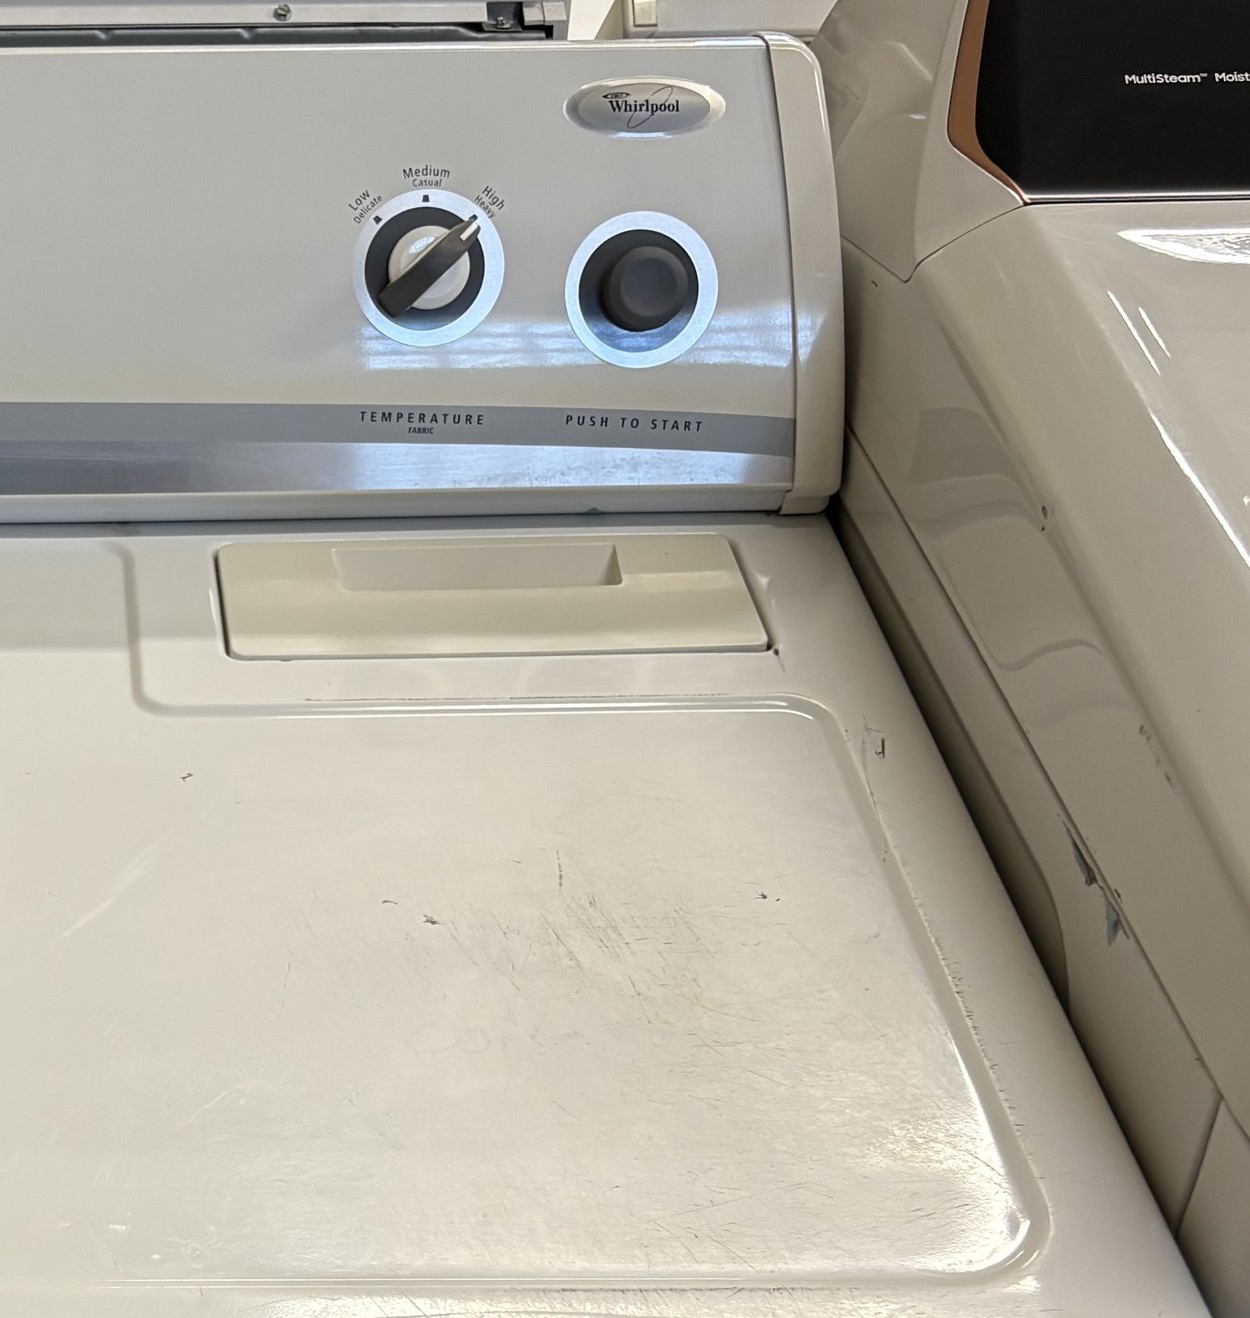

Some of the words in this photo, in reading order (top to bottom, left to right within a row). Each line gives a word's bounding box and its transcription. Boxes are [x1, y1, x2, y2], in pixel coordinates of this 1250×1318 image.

[608, 99, 680, 115] Whirlpool
[402, 165, 451, 180] Medium
[412, 178, 442, 188] Casual
[348, 189, 371, 212] Low
[482, 185, 505, 211] High
[353, 195, 383, 224] Delicate
[474, 195, 496, 219] Heavy
[359, 411, 485, 426] TEMPERATURE
[565, 415, 609, 428] PUSH
[620, 417, 640, 430] TO
[650, 419, 704, 432] START
[408, 427, 434, 435] FABRIC
